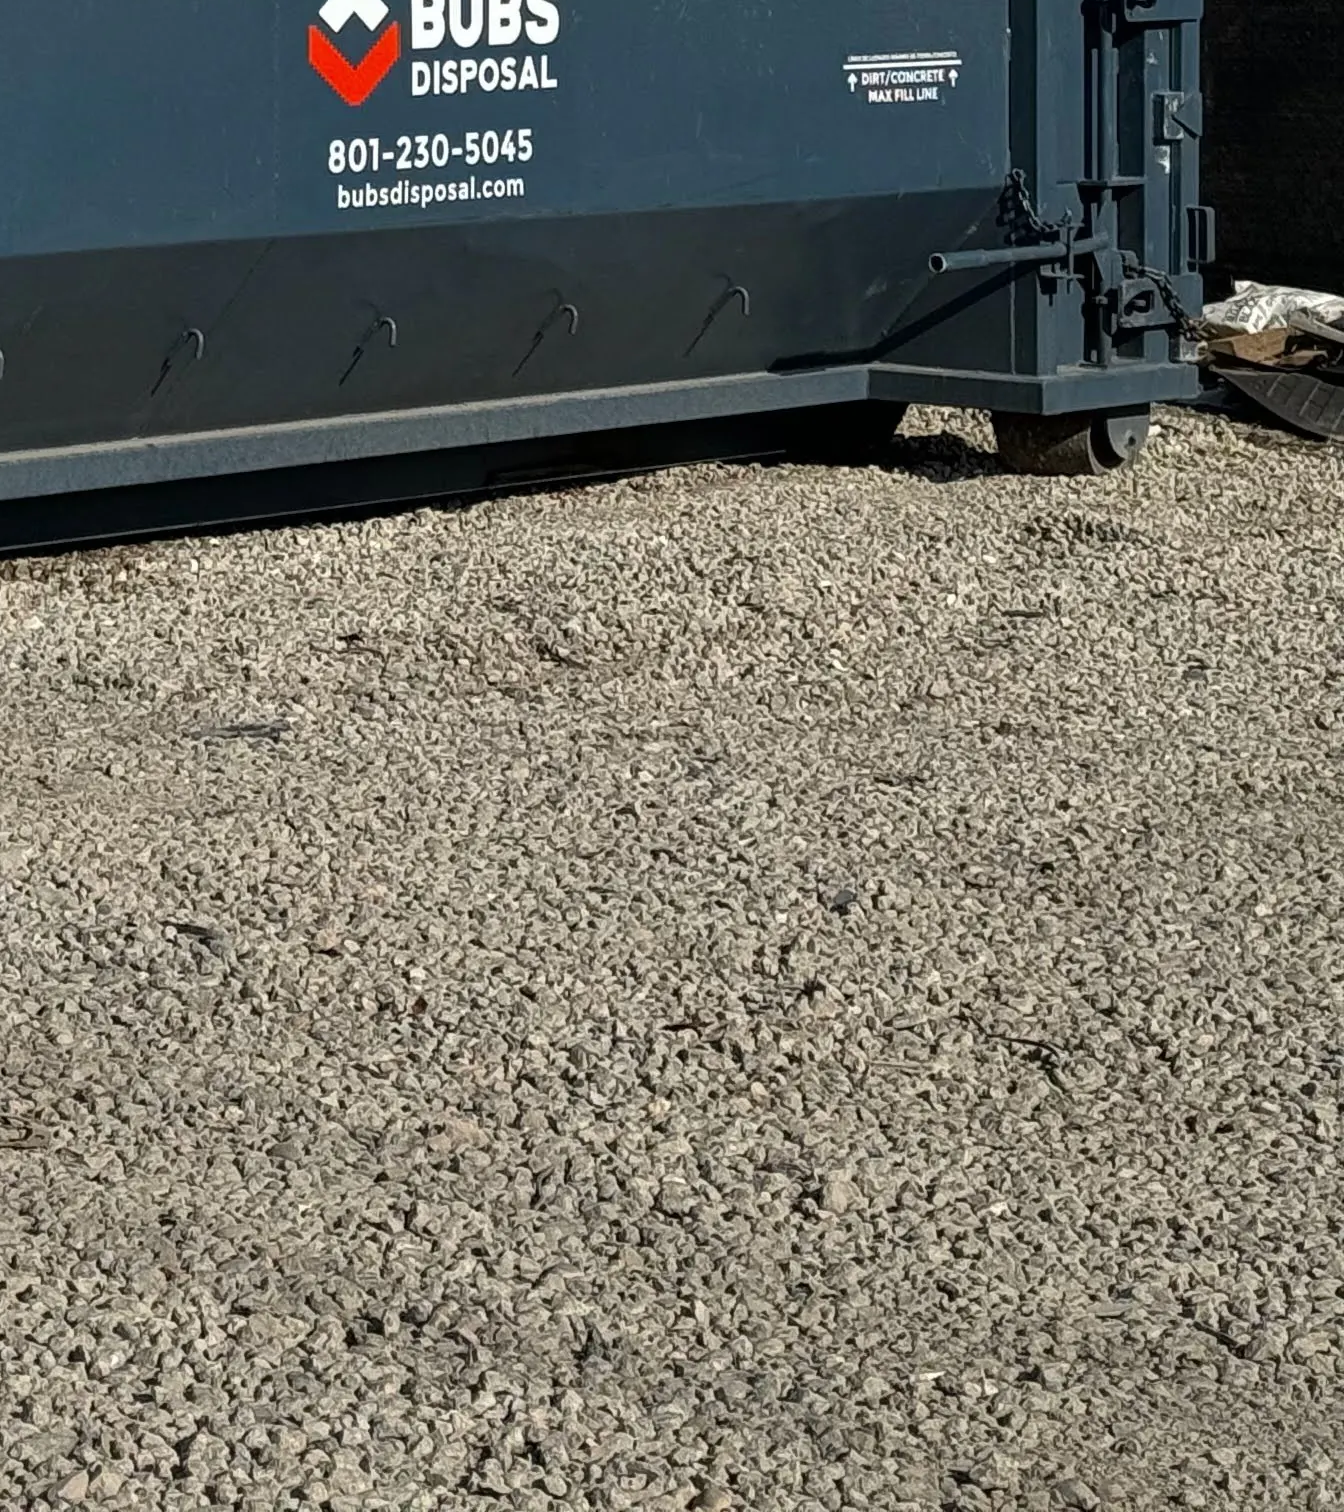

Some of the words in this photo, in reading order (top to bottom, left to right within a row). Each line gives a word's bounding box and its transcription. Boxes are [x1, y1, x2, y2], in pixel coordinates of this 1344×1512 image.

[411, 55, 558, 96] DISPOSAL
[861, 68, 945, 86] DIRT/CONCRETE
[868, 89, 893, 104] MAX
[894, 88, 915, 102] FILL
[916, 87, 939, 101] LINE
[328, 128, 533, 173] 801-230-5045
[337, 175, 525, 209] bubsdisposal.com
